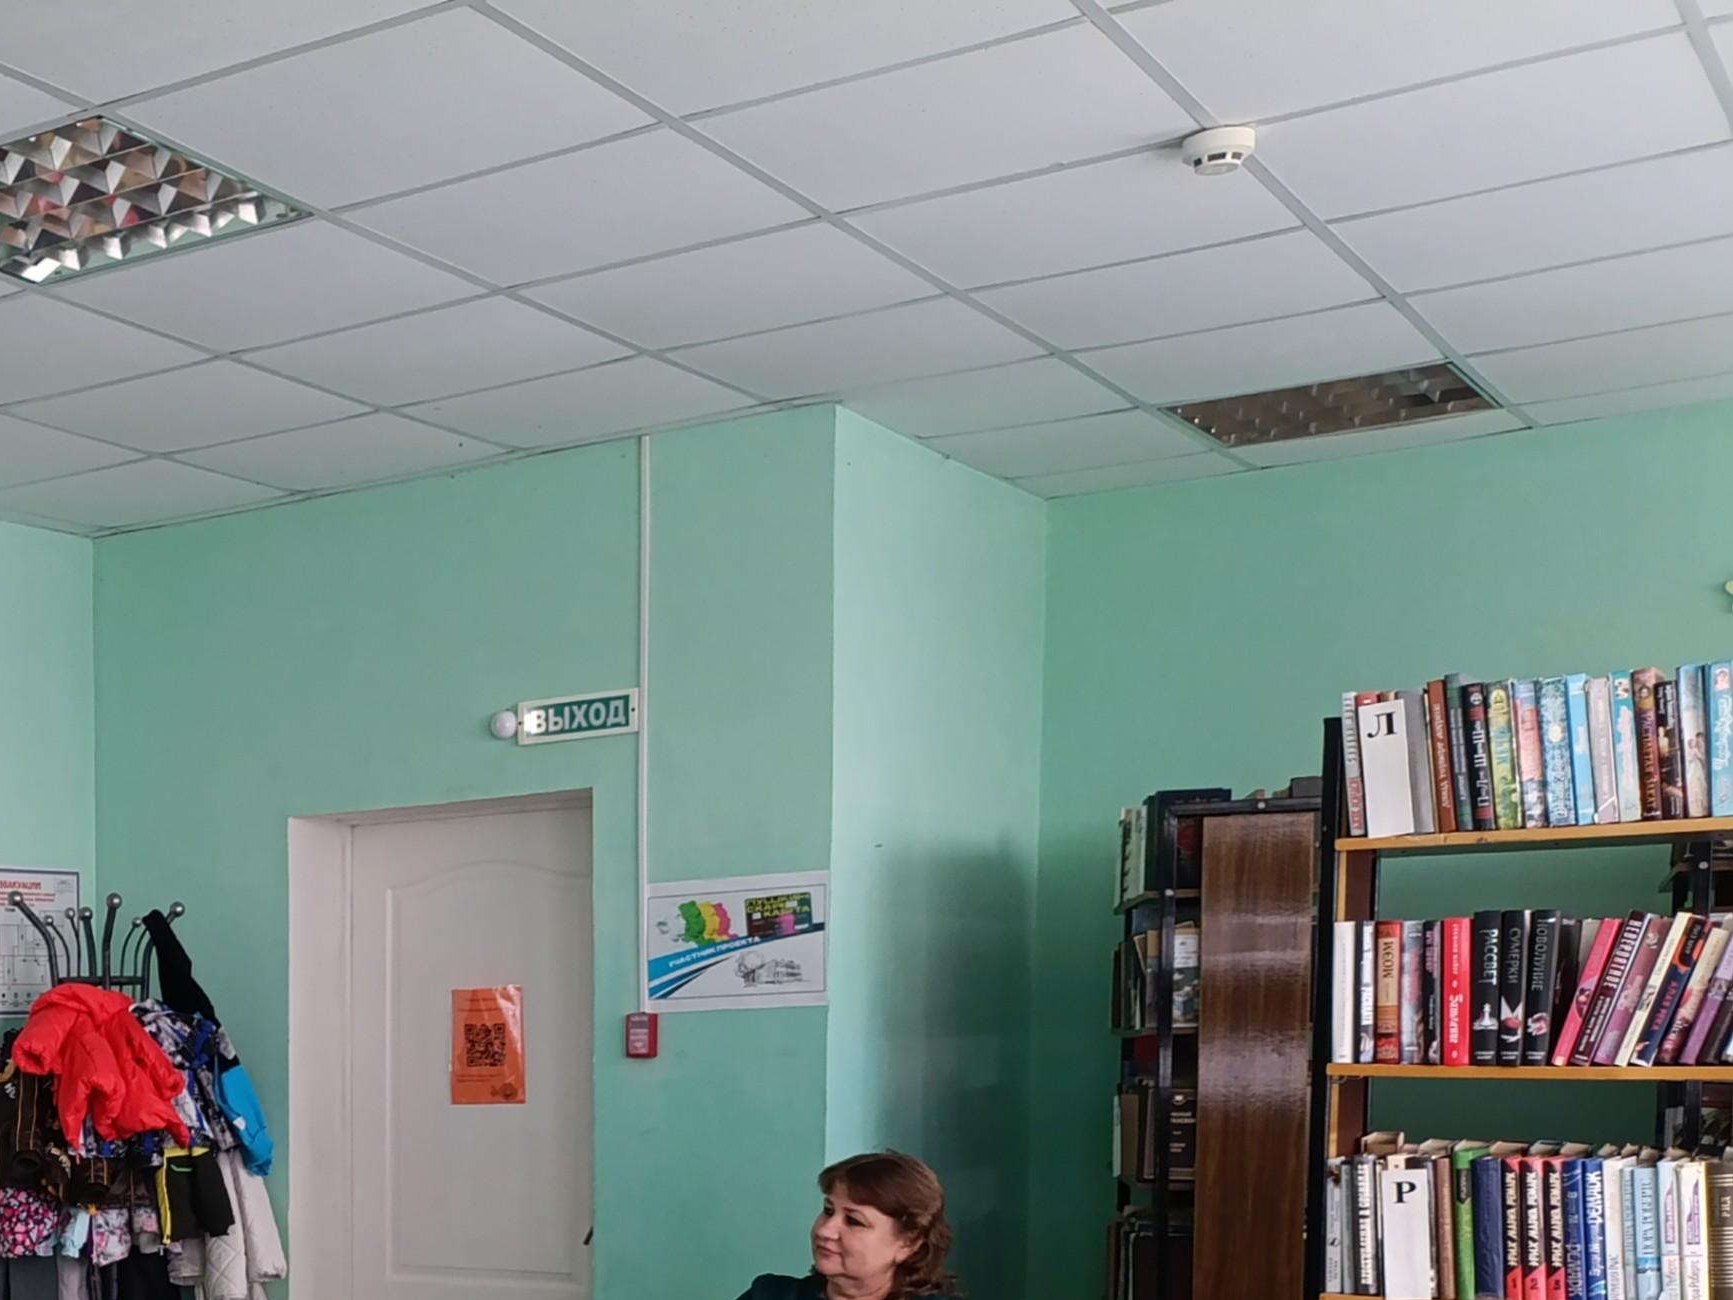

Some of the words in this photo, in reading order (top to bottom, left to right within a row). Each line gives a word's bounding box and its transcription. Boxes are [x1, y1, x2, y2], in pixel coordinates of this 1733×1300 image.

[529, 699, 626, 735] ВЫХОД
[1367, 711, 1397, 739] Л
[1479, 928, 1499, 986] РАССВЕТ
[1506, 927, 1522, 984] СУМЕРКИ
[1531, 918, 1548, 992] НОВОЛУНИЕ
[1393, 1181, 1417, 1204] Р
